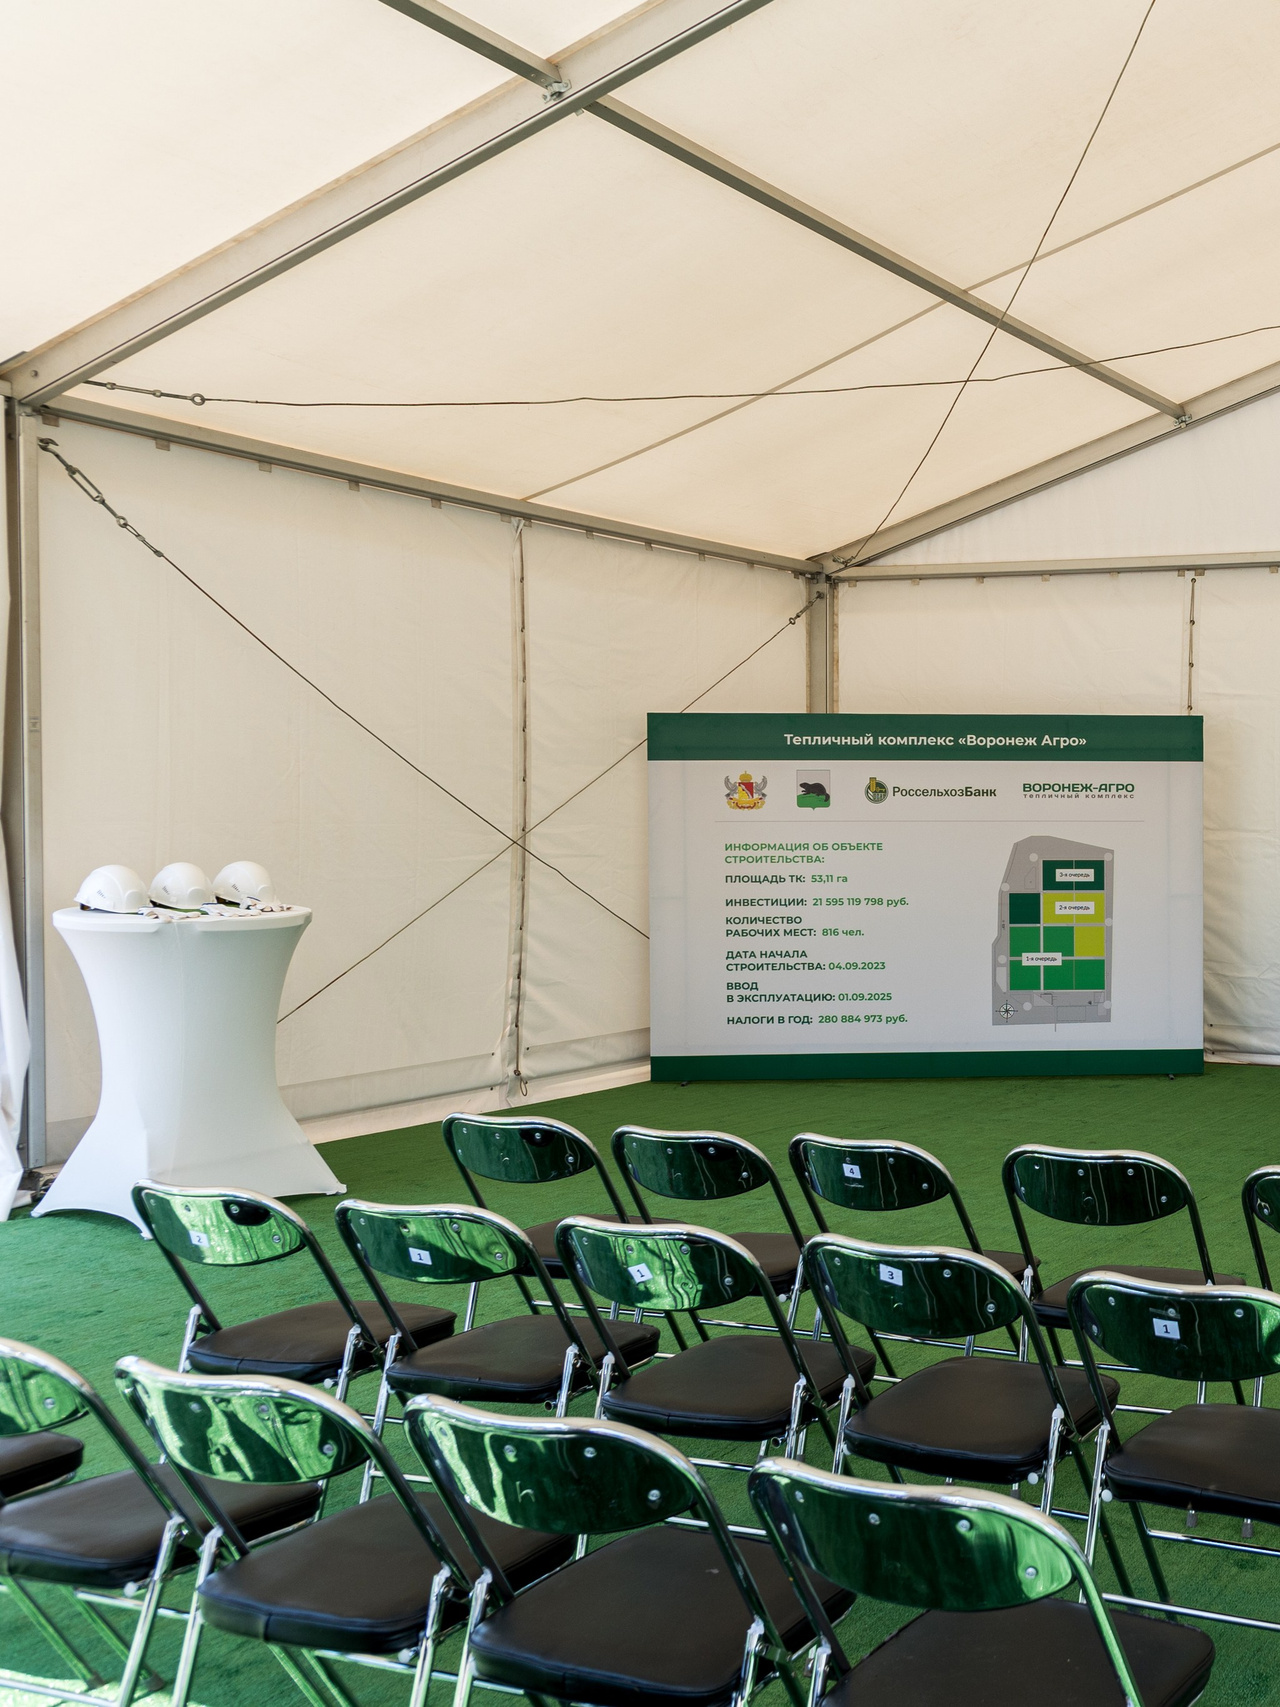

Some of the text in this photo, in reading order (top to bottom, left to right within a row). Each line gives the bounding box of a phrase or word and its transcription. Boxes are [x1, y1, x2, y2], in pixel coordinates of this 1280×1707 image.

[784, 733, 1086, 748] Тепличный комплекс «Воронеж Агро»
[892, 786, 997, 797] РоссельхозБанк
[1023, 783, 1134, 792] ВОРОНЕЖ-АГРО
[725, 843, 809, 852] ИНФОРМАЦИЯ
[832, 842, 883, 851] ОБЪЕКТЕ
[725, 855, 824, 863] СТРОИТЕЛЬСТВА:
[726, 875, 786, 884] ПЛОЩАДЬ
[789, 875, 805, 883] ТК:
[811, 874, 833, 884] 53,11
[726, 898, 807, 908] ИНВЕСТИЦИИ:
[887, 897, 909, 907] руб.
[726, 916, 802, 925] КОЛИЧЕСТВО
[726, 929, 780, 937] РАБОЧИХ
[784, 928, 816, 937] МЕСТ:
[822, 928, 839, 936] 816
[726, 950, 808, 960] ДАТА НАЧАЛА
[726, 962, 885, 971] СТРОИТЕЛЬСТВА: 04.09.2023
[727, 982, 758, 991] ВВОД
[737, 993, 835, 1003] ЭКСПЛУАТАЦИЮ:
[838, 993, 892, 1001] 01.09.2025
[727, 1016, 774, 1024] НАЛОГИ
[778, 1016, 785, 1024] В
[788, 1015, 812, 1025] ГОД:
[818, 1015, 837, 1023] 280
[886, 1014, 907, 1024] руб.
[196, 1235, 202, 1243] 2
[417, 1253, 423, 1261] 1
[637, 1269, 645, 1278] 1
[888, 1271, 894, 1280] 3
[1163, 1324, 1170, 1334] 1
